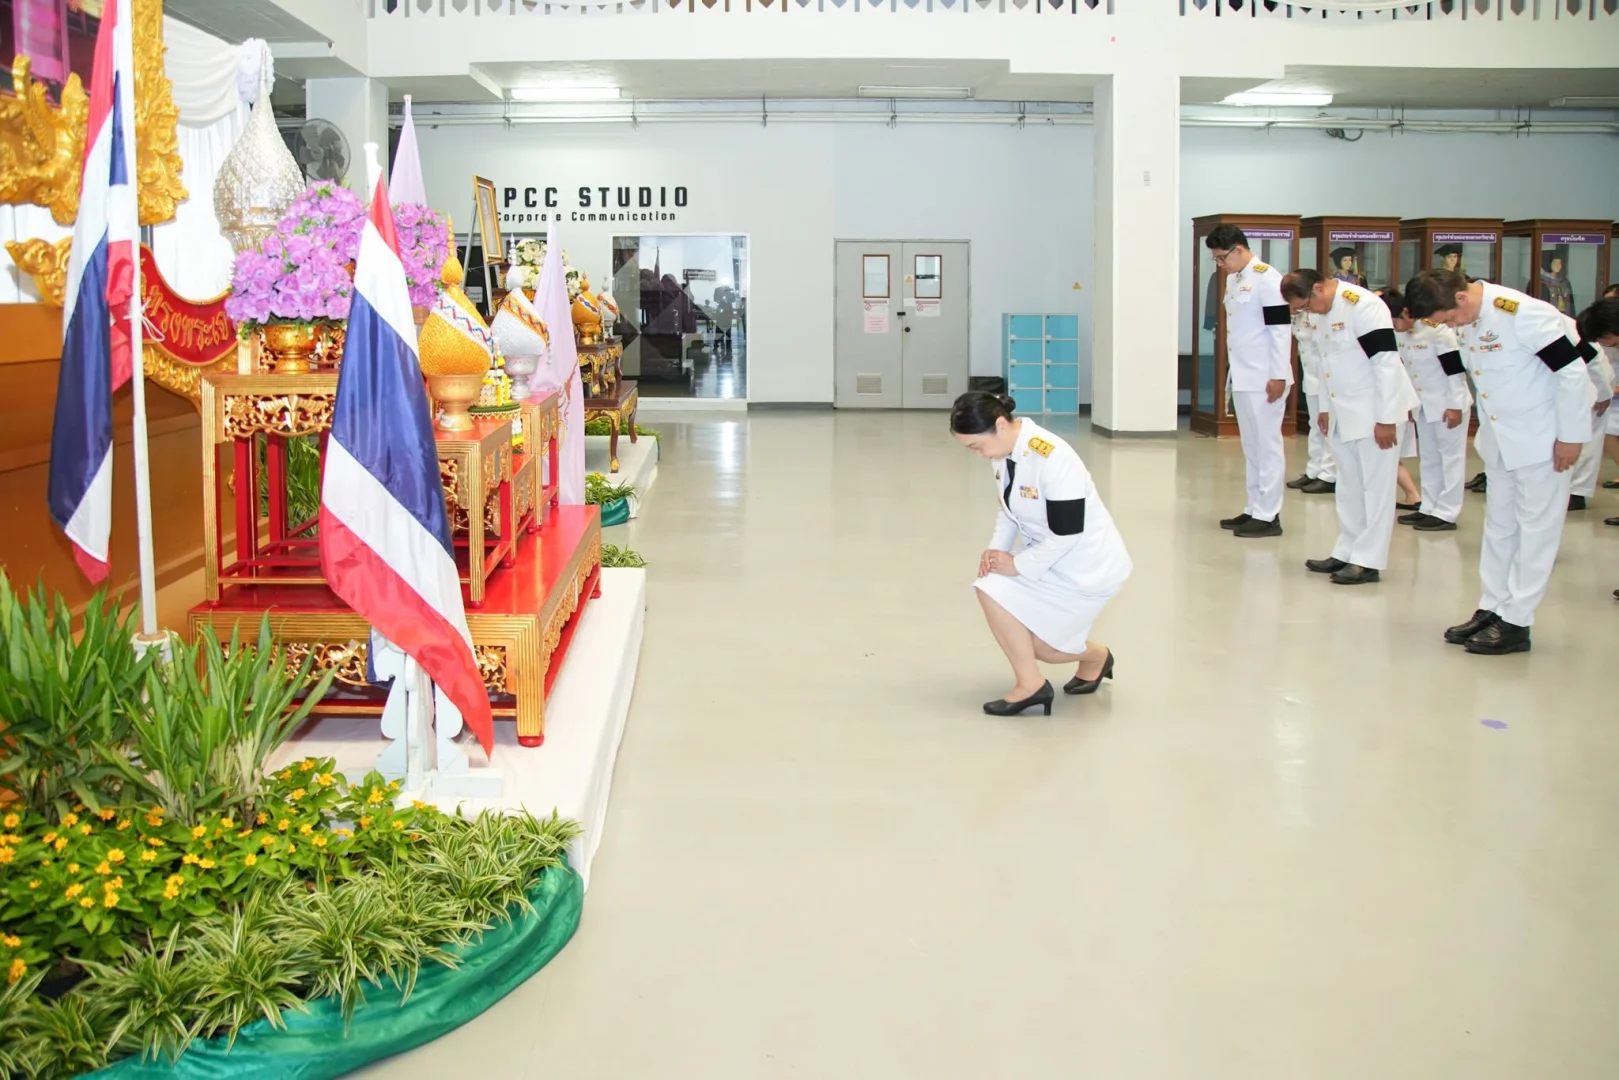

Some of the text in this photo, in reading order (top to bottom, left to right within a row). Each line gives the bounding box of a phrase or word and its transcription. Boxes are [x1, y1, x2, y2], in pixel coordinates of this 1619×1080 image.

[494, 186, 688, 208] PCC STUDIO
[497, 211, 676, 223] Corporae Communication
